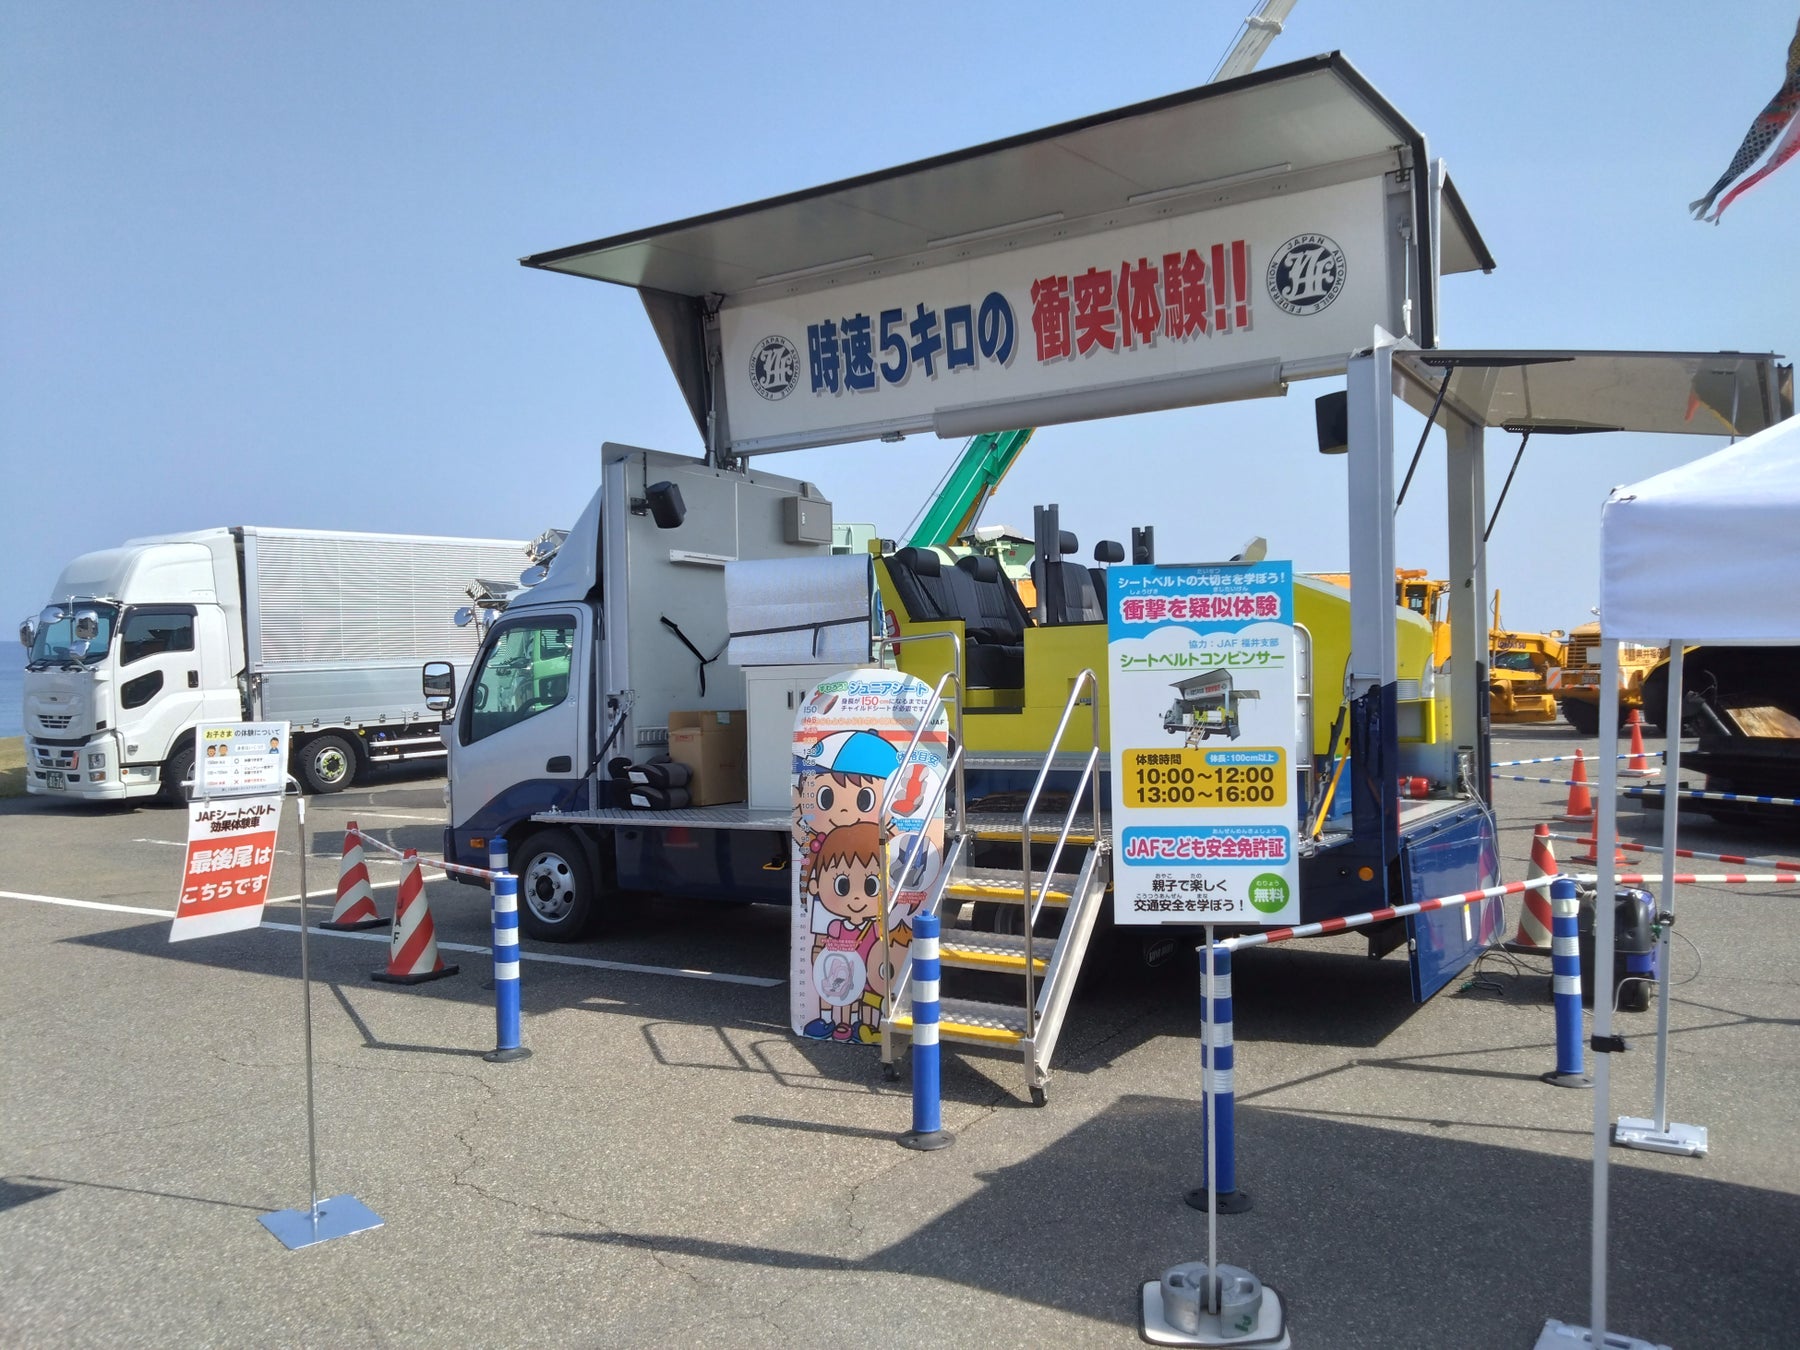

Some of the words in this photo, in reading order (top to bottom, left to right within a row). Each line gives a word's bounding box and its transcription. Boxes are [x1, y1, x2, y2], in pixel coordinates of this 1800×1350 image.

[1286, 236, 1325, 250] JAPAN
[1268, 261, 1302, 313] FEDERATION
[1313, 249, 1344, 311] AUTOMOBILE
[807, 292, 1014, 394] 時速5キロの
[1030, 240, 1248, 361] 衝突体験!!
[761, 336, 786, 348] JAPAN
[750, 356, 775, 399] FEDERATION
[780, 349, 800, 397] AUTOMOBILE
[1118, 572, 1285, 589] シートベルトの大切さを学ぼう！
[1122, 595, 1278, 620] 衝撃を疑似体験
[1241, 638, 1280, 648] 福井支部
[1120, 650, 1285, 668] シートベルトコンビンサー
[849, 681, 928, 695] ジュニアシート
[206, 730, 232, 739] お子さま
[1136, 754, 1182, 765] 体験時間
[195, 804, 276, 822] JAFシートベルト
[210, 816, 260, 833] 効果体験車
[1127, 837, 1285, 858] JAFこども安全免許証
[189, 845, 273, 875] 最後尾は
[182, 874, 268, 904] こちらです
[1152, 879, 1227, 892] 親子で楽しく
[1254, 887, 1285, 903] 無料
[1134, 899, 1243, 911] 交通安全を学ぼう！
